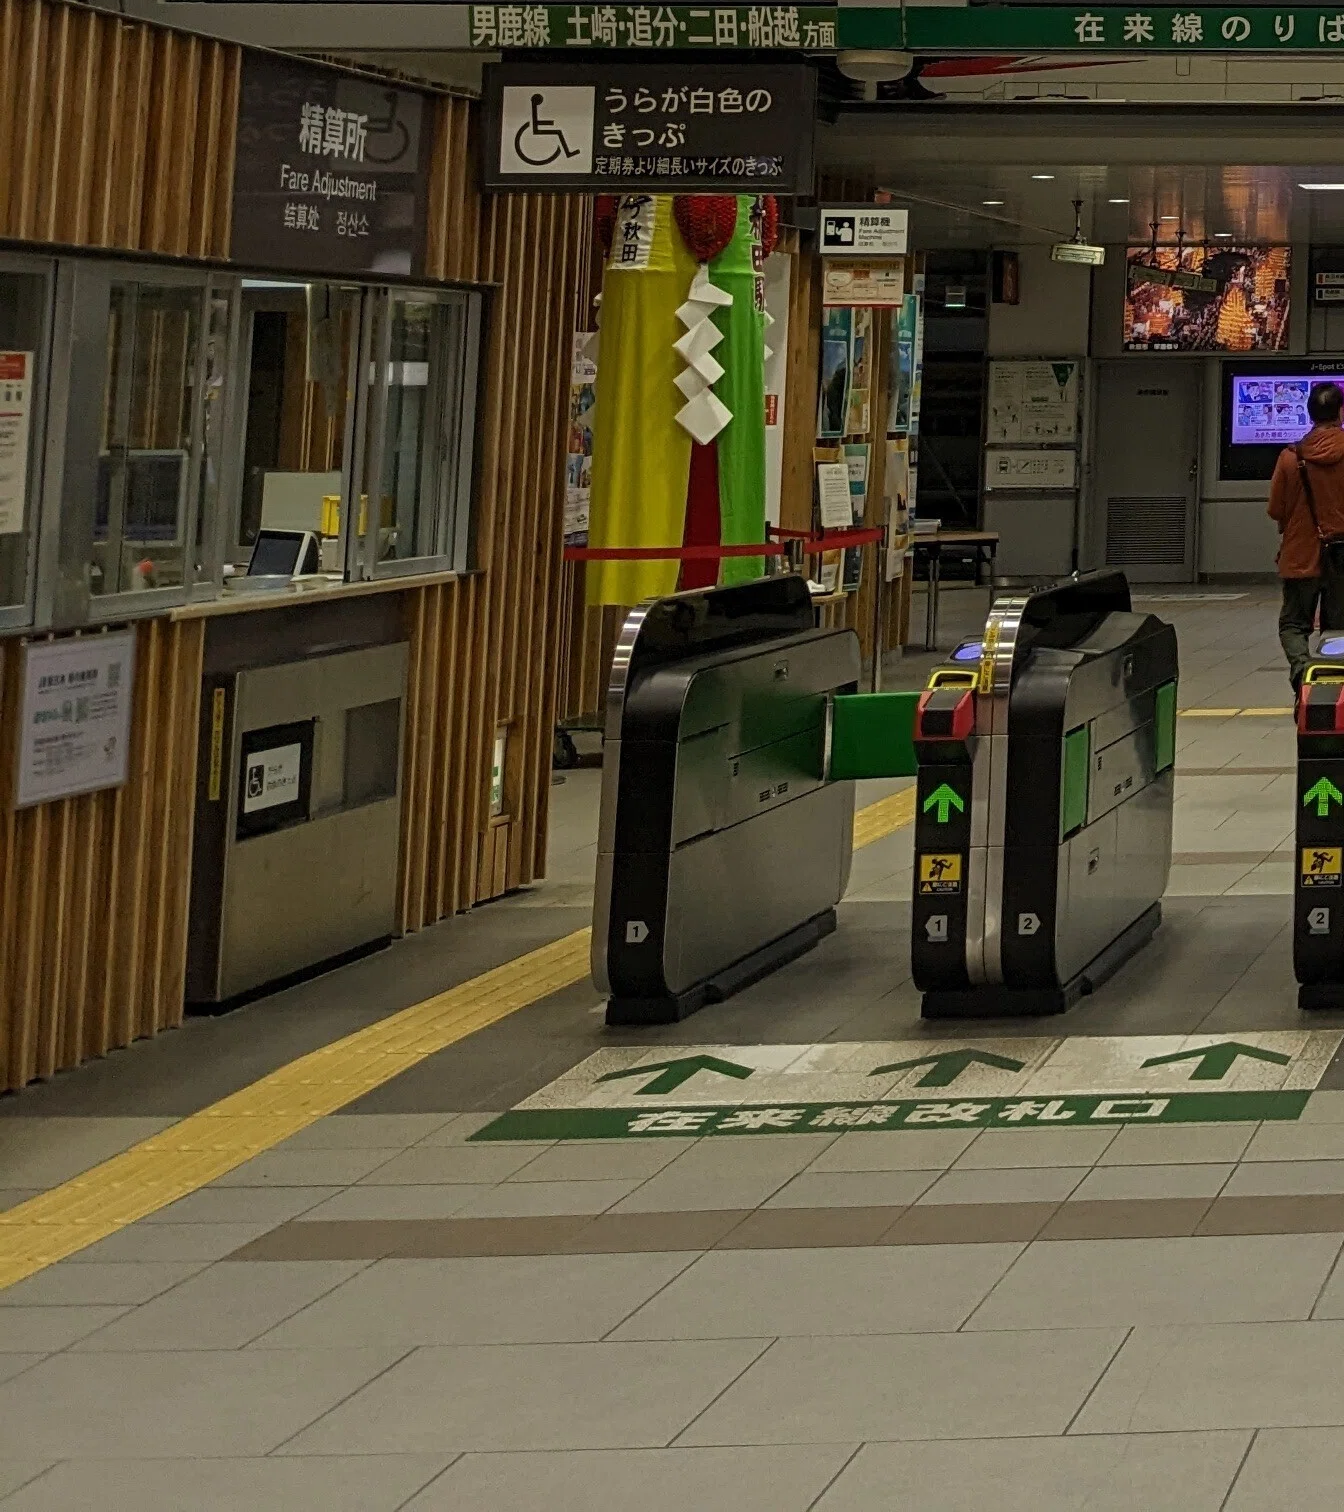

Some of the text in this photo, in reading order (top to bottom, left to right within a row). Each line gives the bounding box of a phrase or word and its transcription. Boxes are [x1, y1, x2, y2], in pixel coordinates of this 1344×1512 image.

[471, 6, 551, 46] 男鹿線
[605, 86, 772, 114] うらが白色の
[299, 101, 367, 163] 精算所
[603, 122, 686, 148] きっぷ
[280, 164, 377, 202] Fare Adjustment
[627, 1096, 1171, 1132] 在来線改札口
